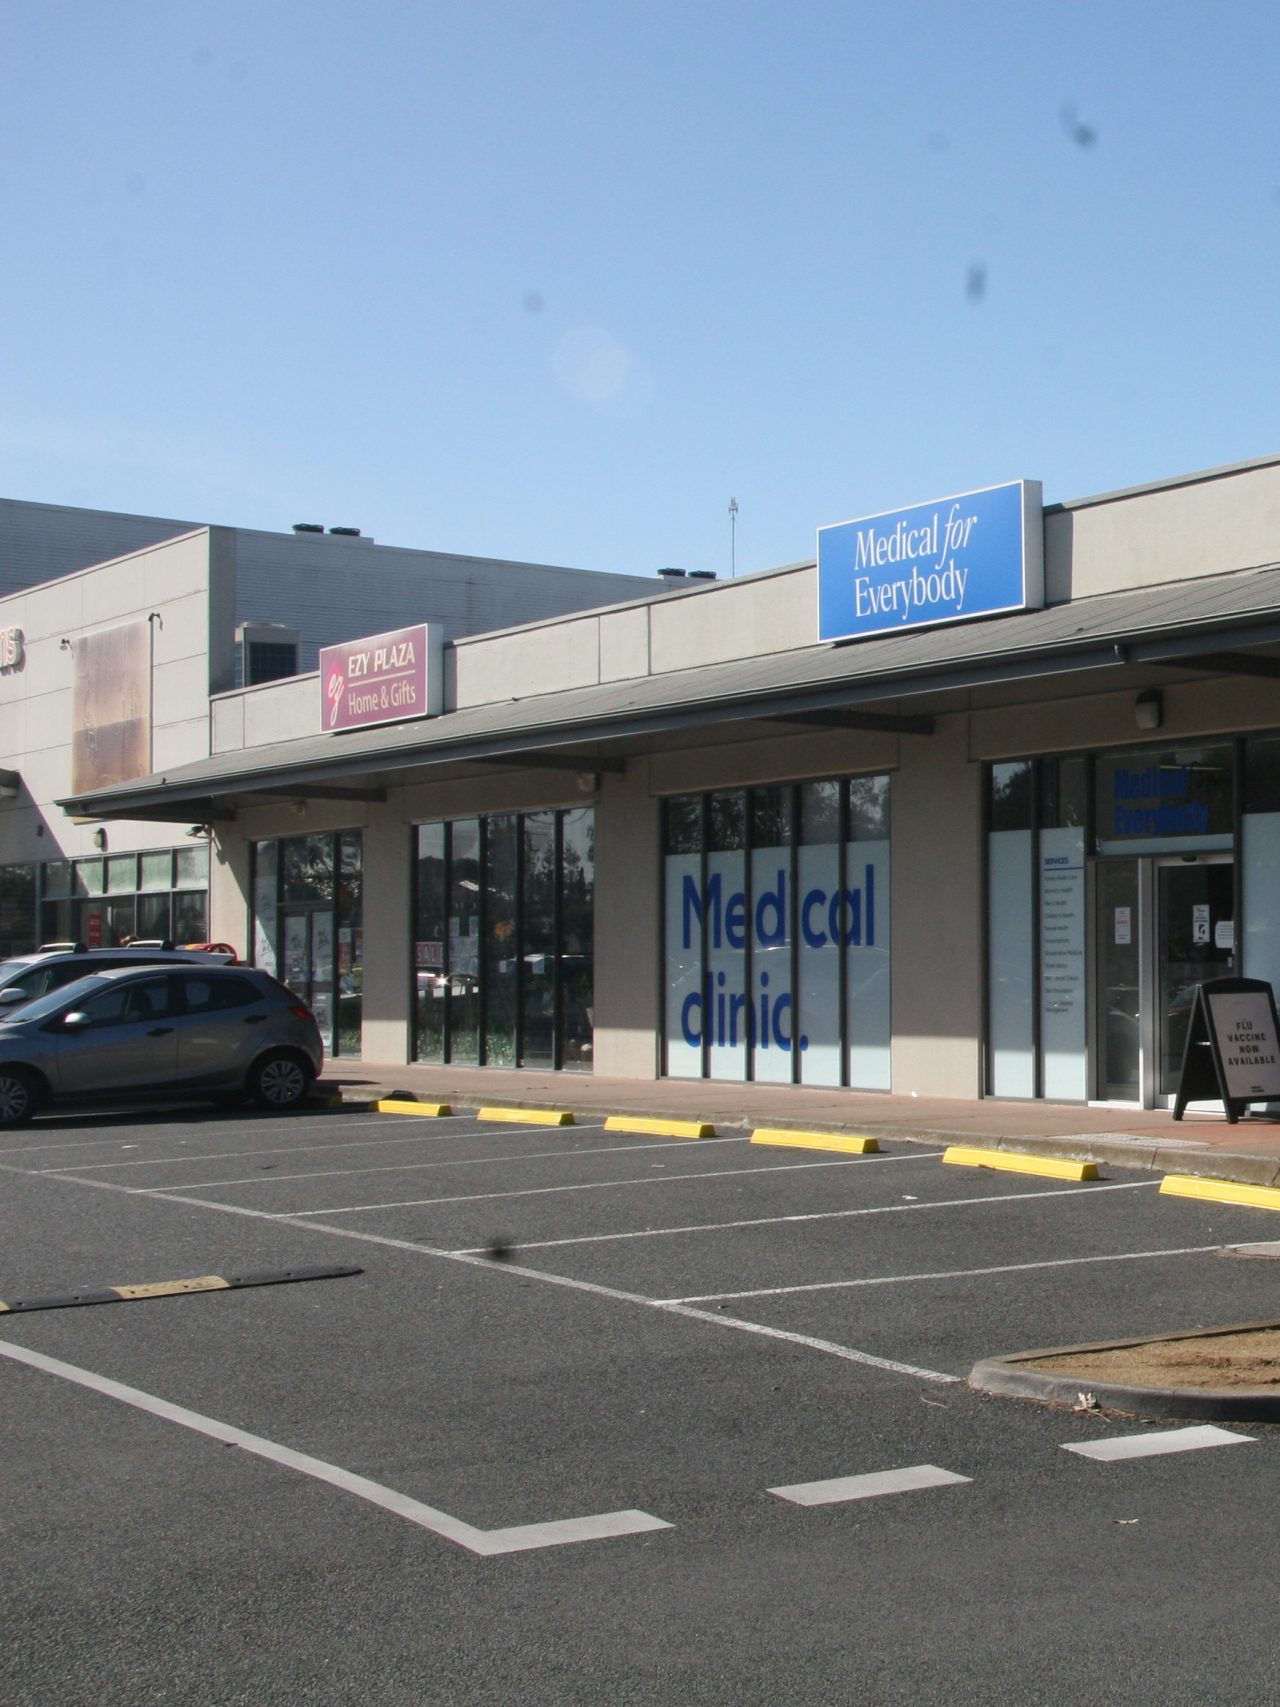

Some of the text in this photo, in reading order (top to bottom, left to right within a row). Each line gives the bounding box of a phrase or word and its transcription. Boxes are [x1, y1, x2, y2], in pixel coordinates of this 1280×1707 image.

[854, 504, 978, 570] Medical for
[855, 558, 968, 620] Everybody
[348, 642, 416, 678] EZY PLAZA
[348, 680, 416, 716] Home & Gifts
[682, 864, 875, 950] Medcal
[1227, 1033, 1266, 1042] VACCINE
[1236, 1022, 1253, 1030] FLU
[1228, 1056, 1276, 1066] AVAILABLE
[1239, 1045, 1259, 1053] NOW
